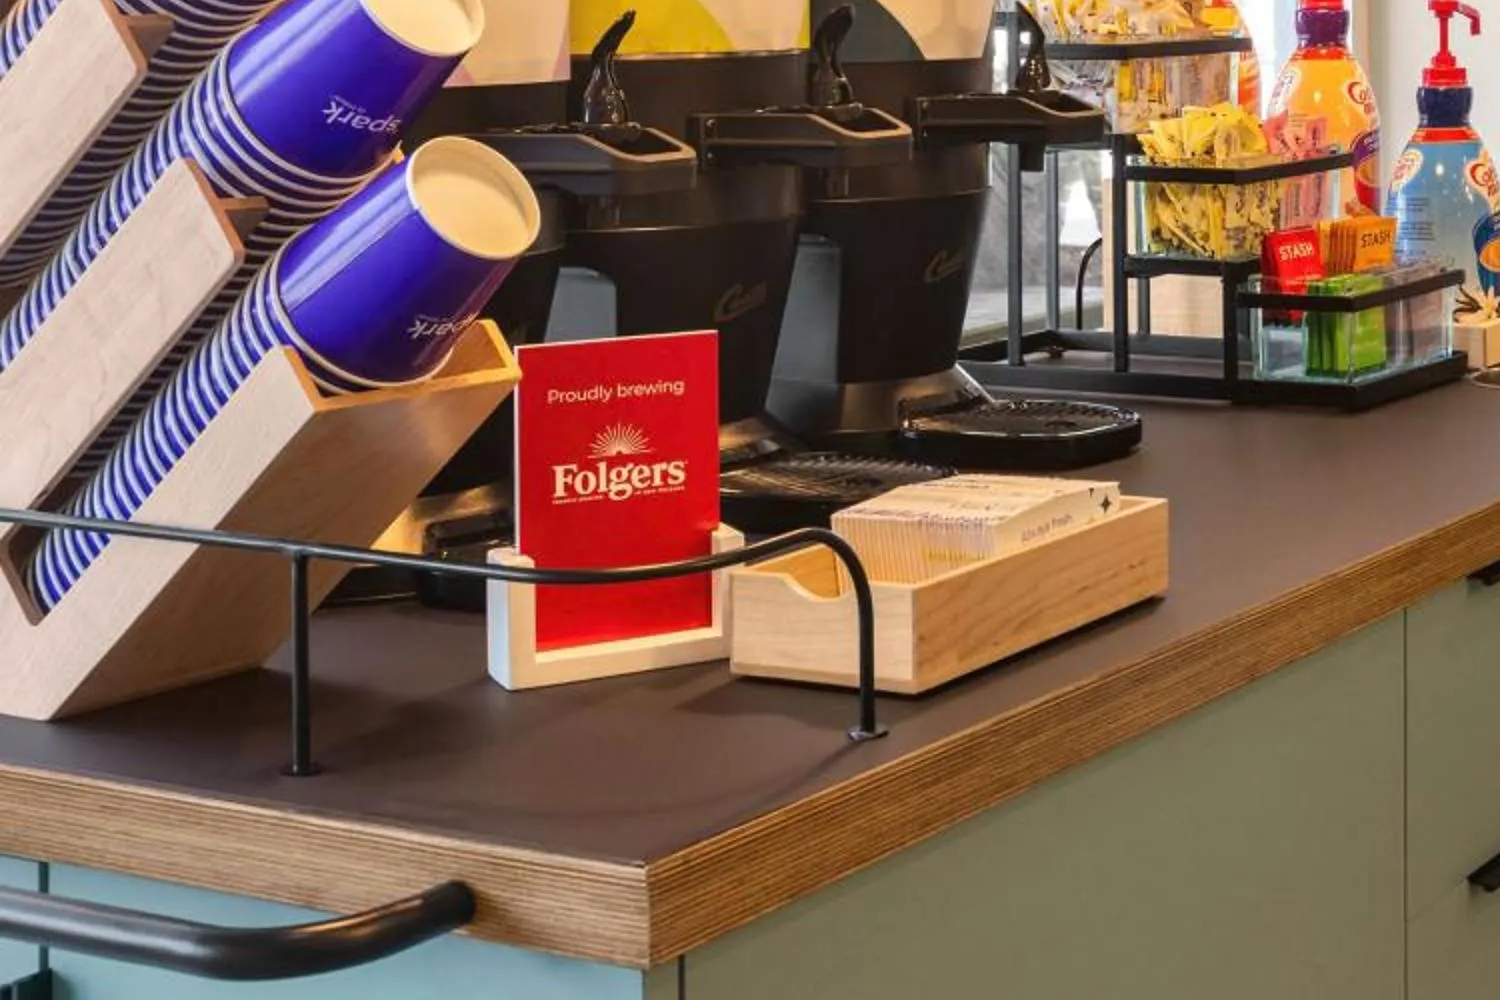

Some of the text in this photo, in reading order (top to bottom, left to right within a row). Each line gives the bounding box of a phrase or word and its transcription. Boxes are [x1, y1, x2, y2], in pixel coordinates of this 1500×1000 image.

[1279, 241, 1313, 261] STASH
[547, 379, 685, 404] Proudly brewing
[552, 460, 686, 501] Folgers
